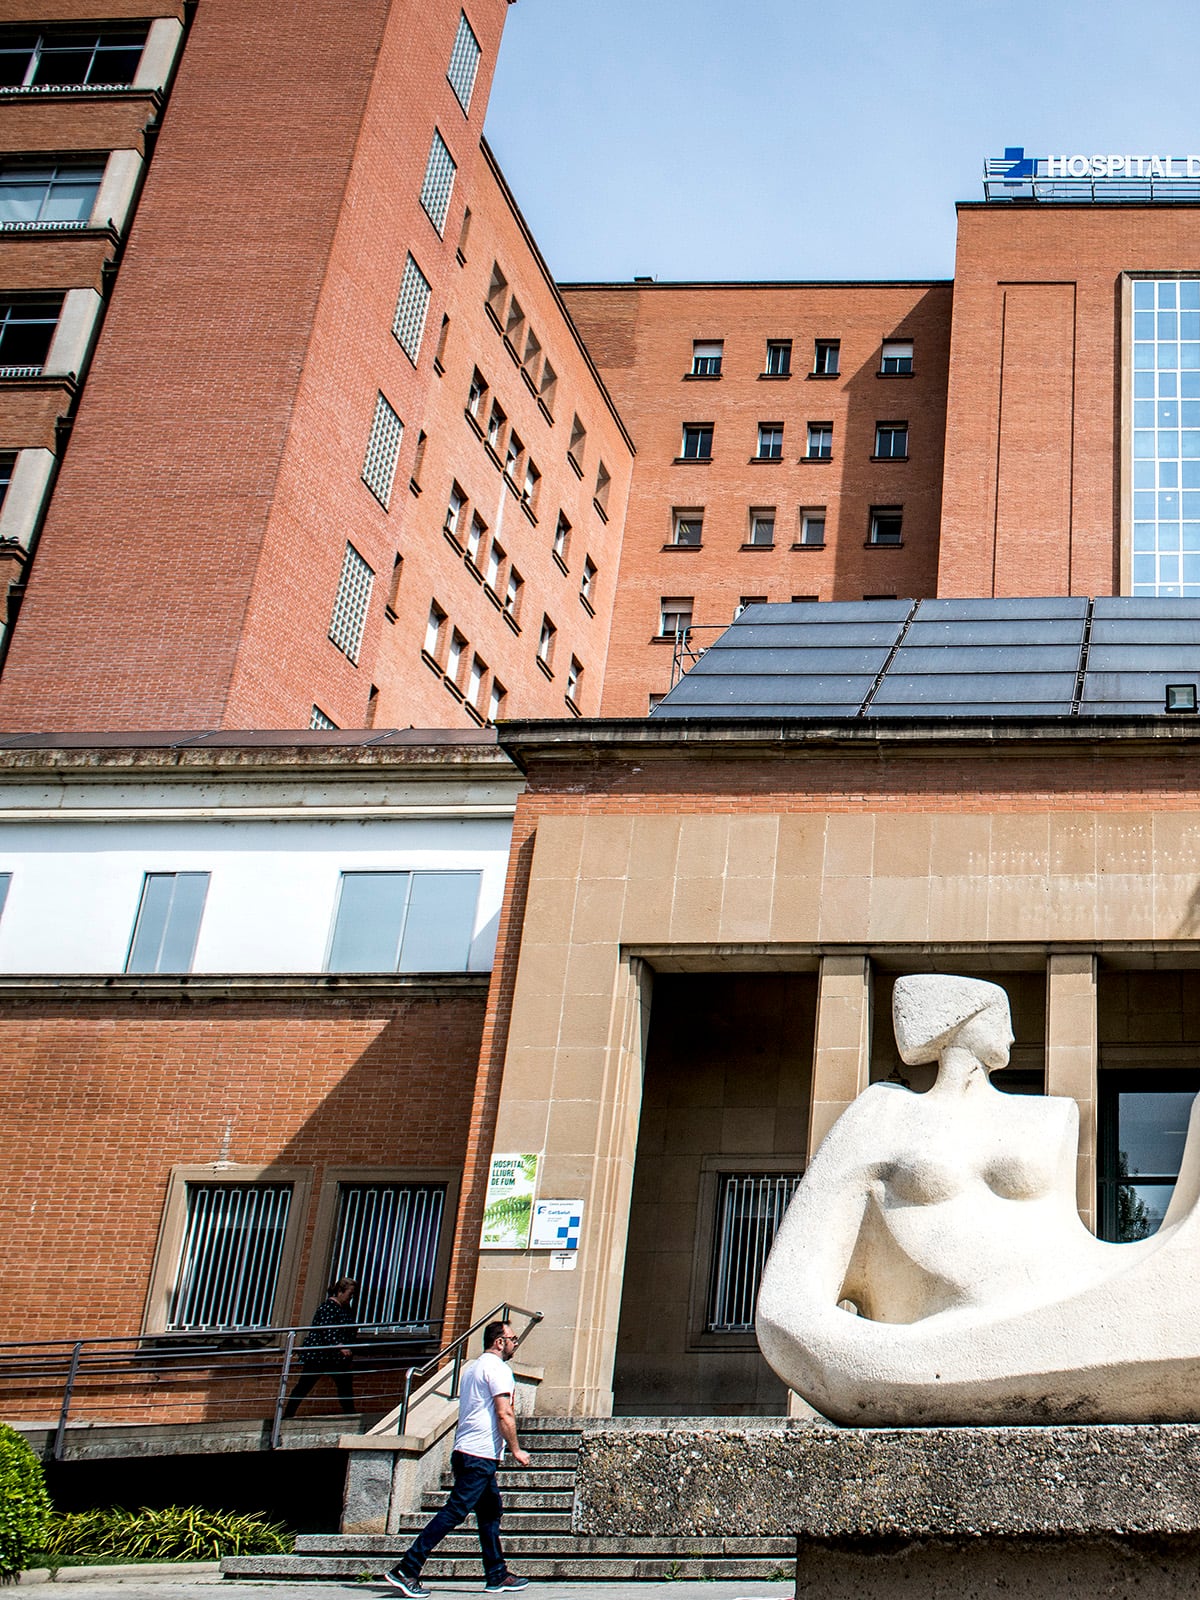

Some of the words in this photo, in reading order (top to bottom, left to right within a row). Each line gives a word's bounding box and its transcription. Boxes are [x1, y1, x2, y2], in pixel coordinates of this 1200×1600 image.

[1047, 154, 1184, 178] HOSPITAL
[494, 1160, 524, 1168] HOSPITAL
[492, 1169, 515, 1177] LLIURE
[491, 1178, 500, 1186] DE
[500, 1178, 516, 1186] FUM
